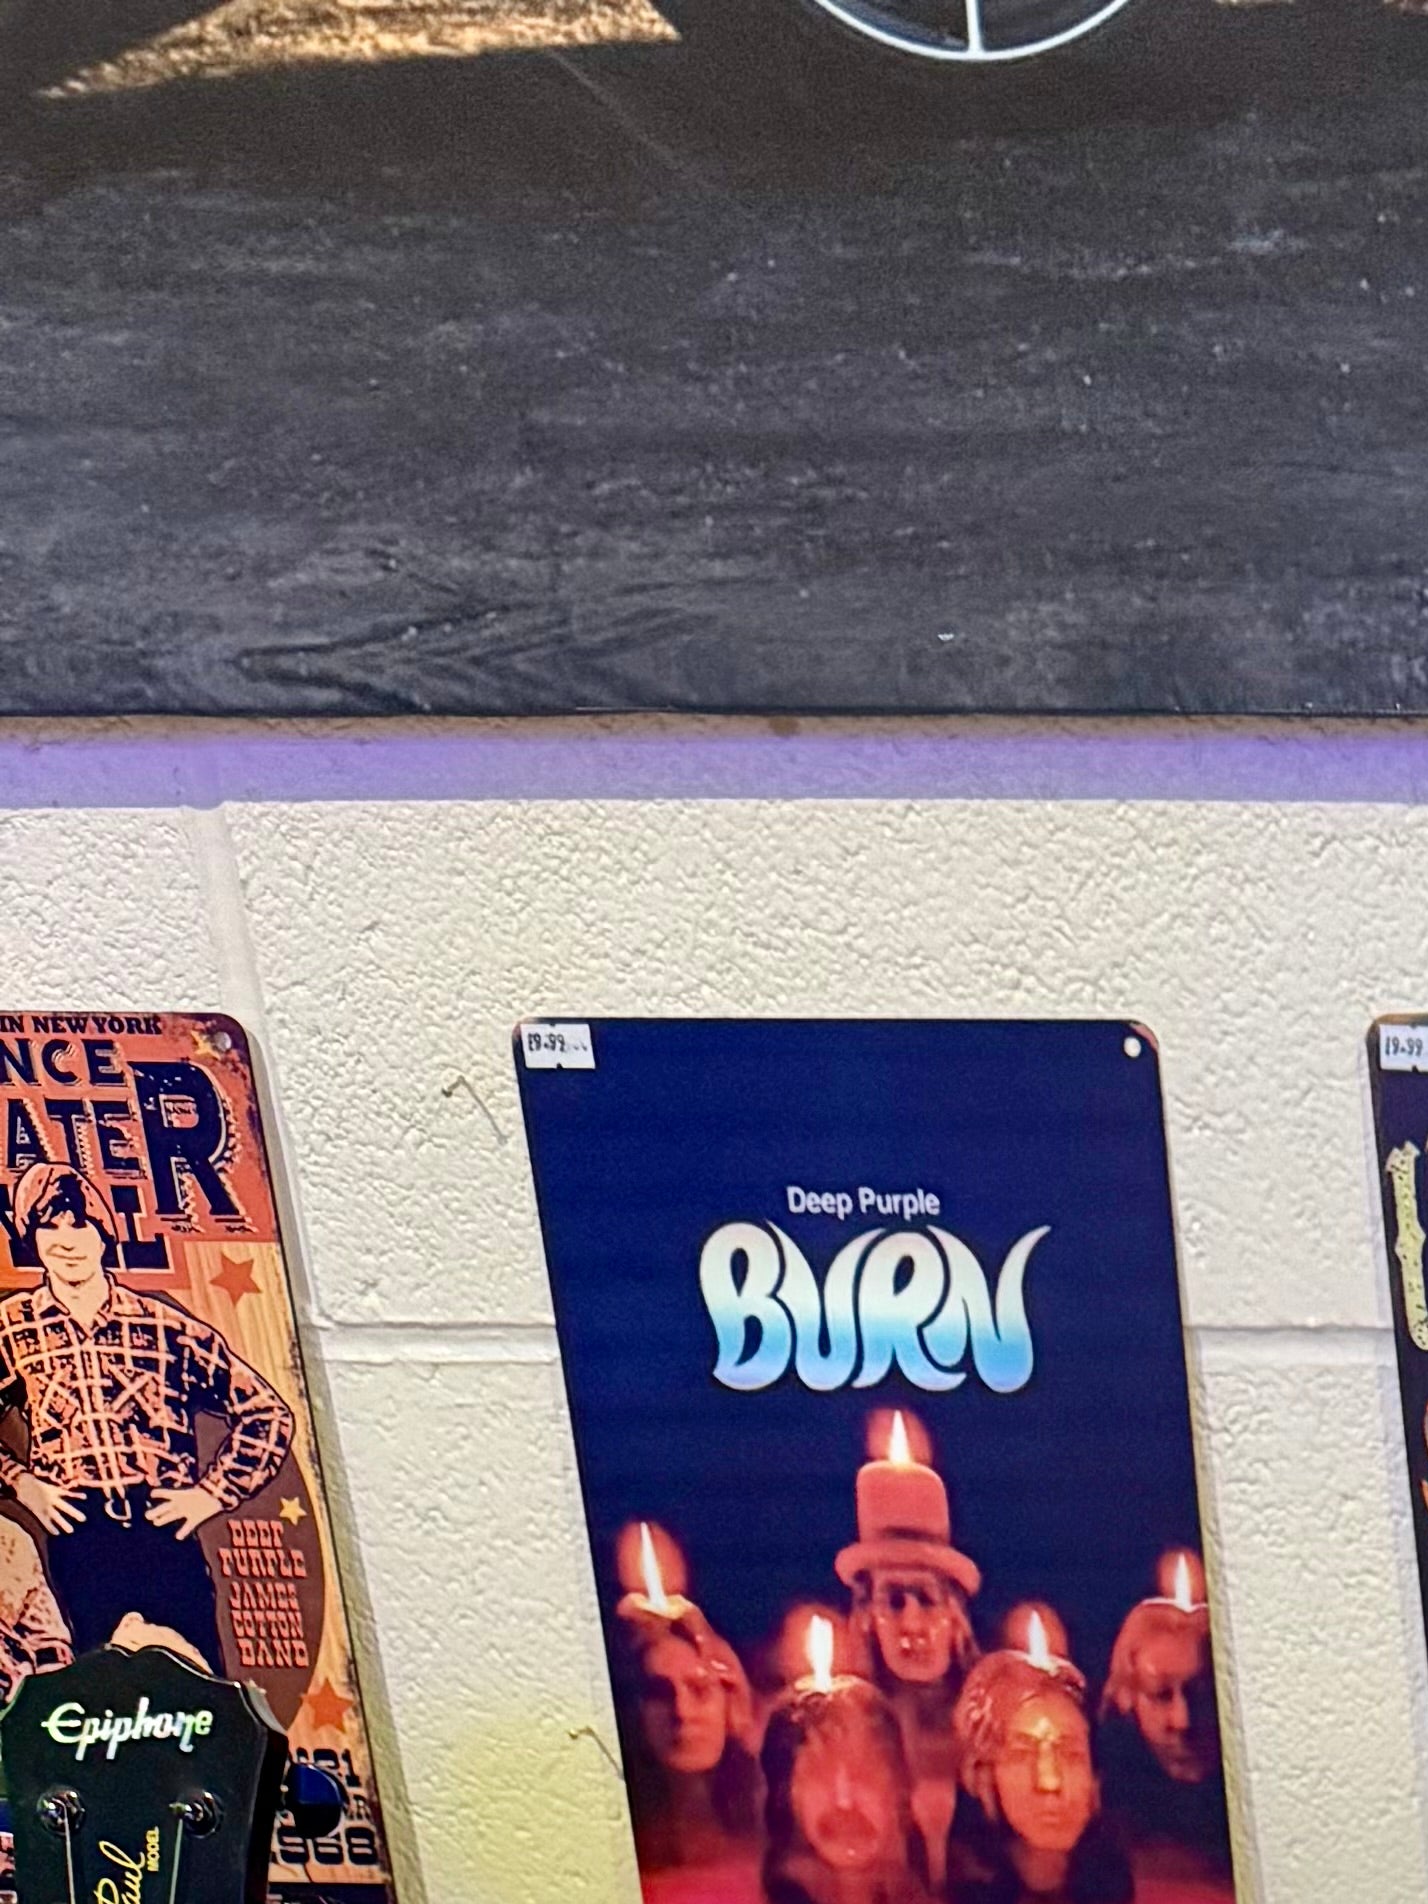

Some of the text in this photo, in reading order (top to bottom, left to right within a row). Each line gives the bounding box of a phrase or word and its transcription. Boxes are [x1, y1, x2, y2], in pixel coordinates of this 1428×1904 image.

[0, 1015, 162, 1035] IN NEW YORK
[786, 1186, 940, 1223] Deep Purple
[699, 1217, 1053, 1393] BURN
[218, 1547, 308, 1578] PURPLE
[229, 1580, 300, 1610] JAMES
[231, 1610, 304, 1639] COTTON
[41, 1697, 214, 1761] Epiphone
[147, 1826, 160, 1873] MODEL
